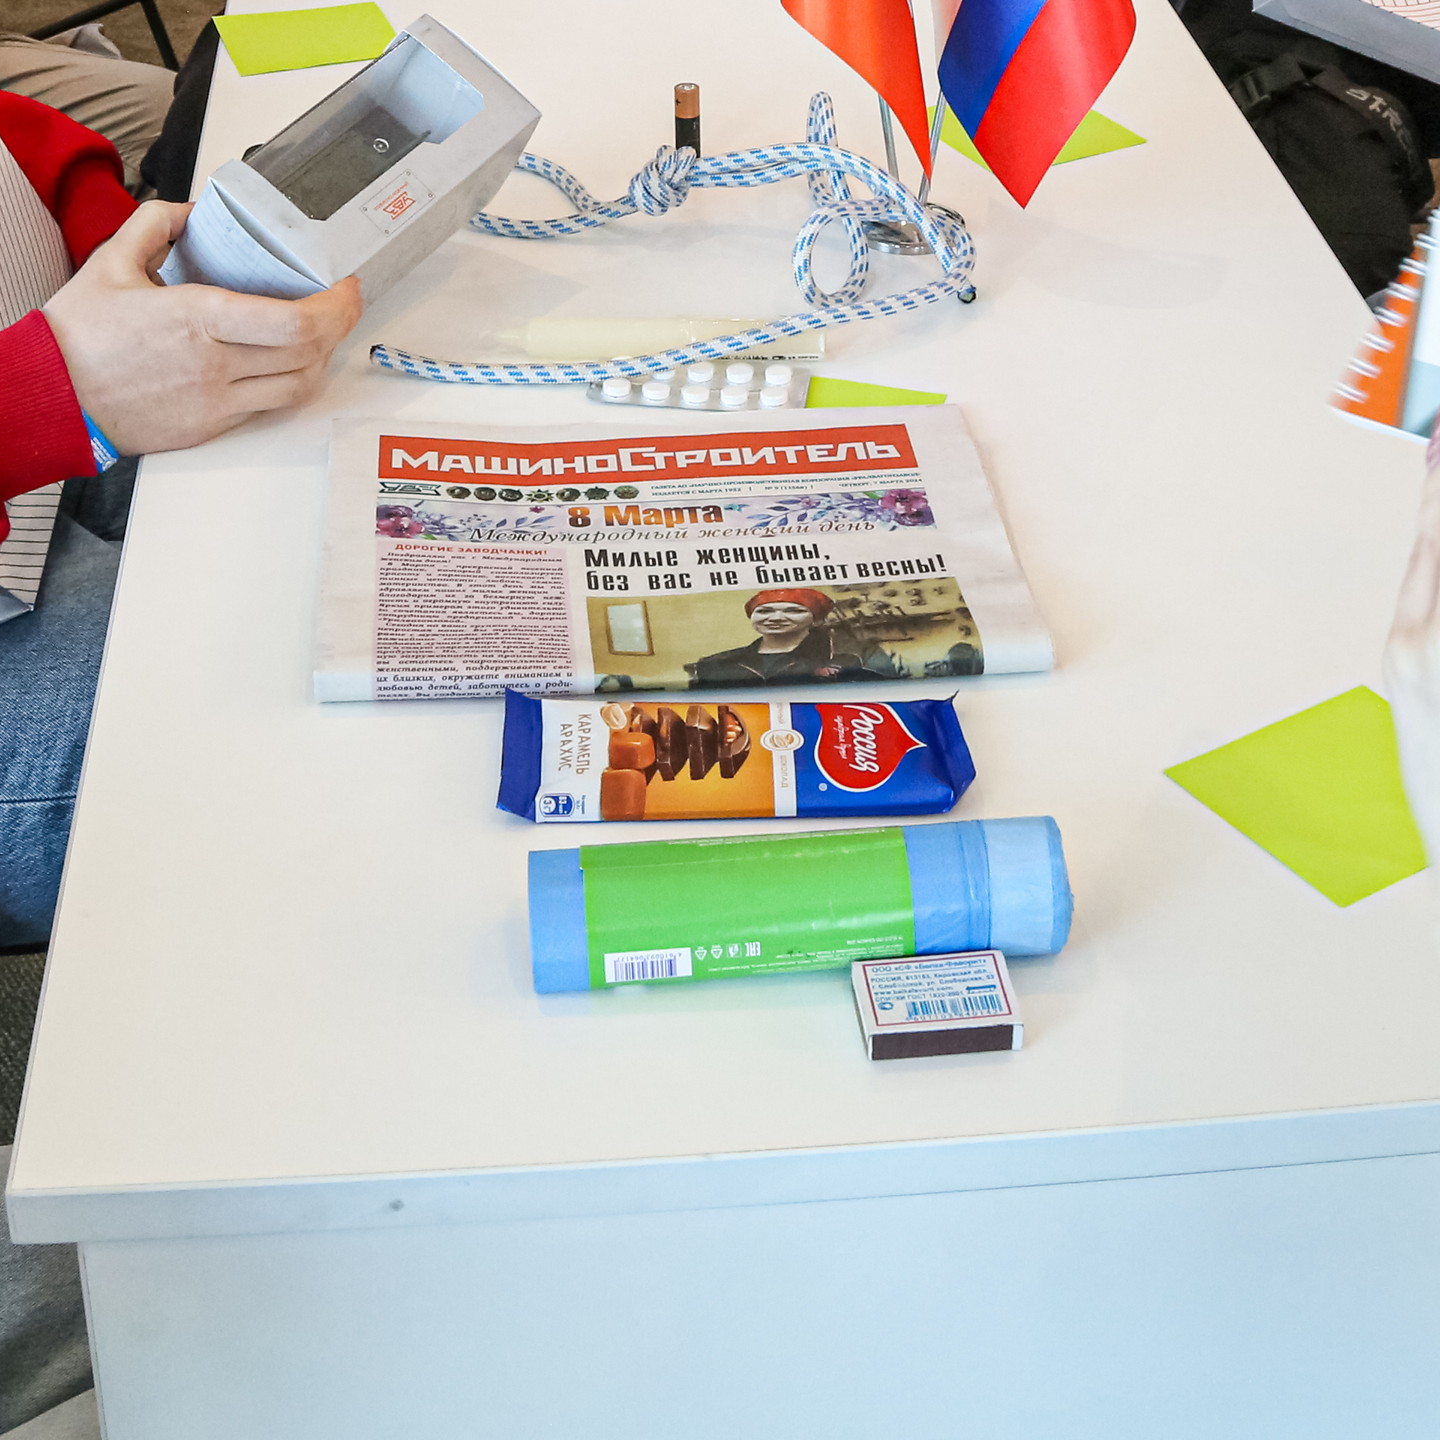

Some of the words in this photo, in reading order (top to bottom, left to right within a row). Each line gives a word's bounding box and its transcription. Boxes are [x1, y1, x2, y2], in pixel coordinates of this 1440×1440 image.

[568, 506, 591, 528] 8
[604, 504, 724, 528] Марта
[470, 526, 688, 544] Международный
[697, 524, 810, 538] женский
[819, 519, 875, 533] день
[395, 544, 453, 552] ДОРОГИЕ
[584, 549, 678, 568] Милые
[696, 543, 830, 566] женщины,
[587, 571, 629, 591] без
[648, 572, 692, 590] вас
[710, 570, 738, 587] не
[756, 564, 849, 585] бывает
[858, 554, 947, 578] весны!
[393, 675, 436, 683] близких,
[442, 674, 499, 682] окружаете
[546, 680, 572, 689] роди-
[558, 723, 573, 771] АРАХИС
[576, 714, 592, 775] КАРАМЕЛЬ
[843, 704, 885, 773] Россия
